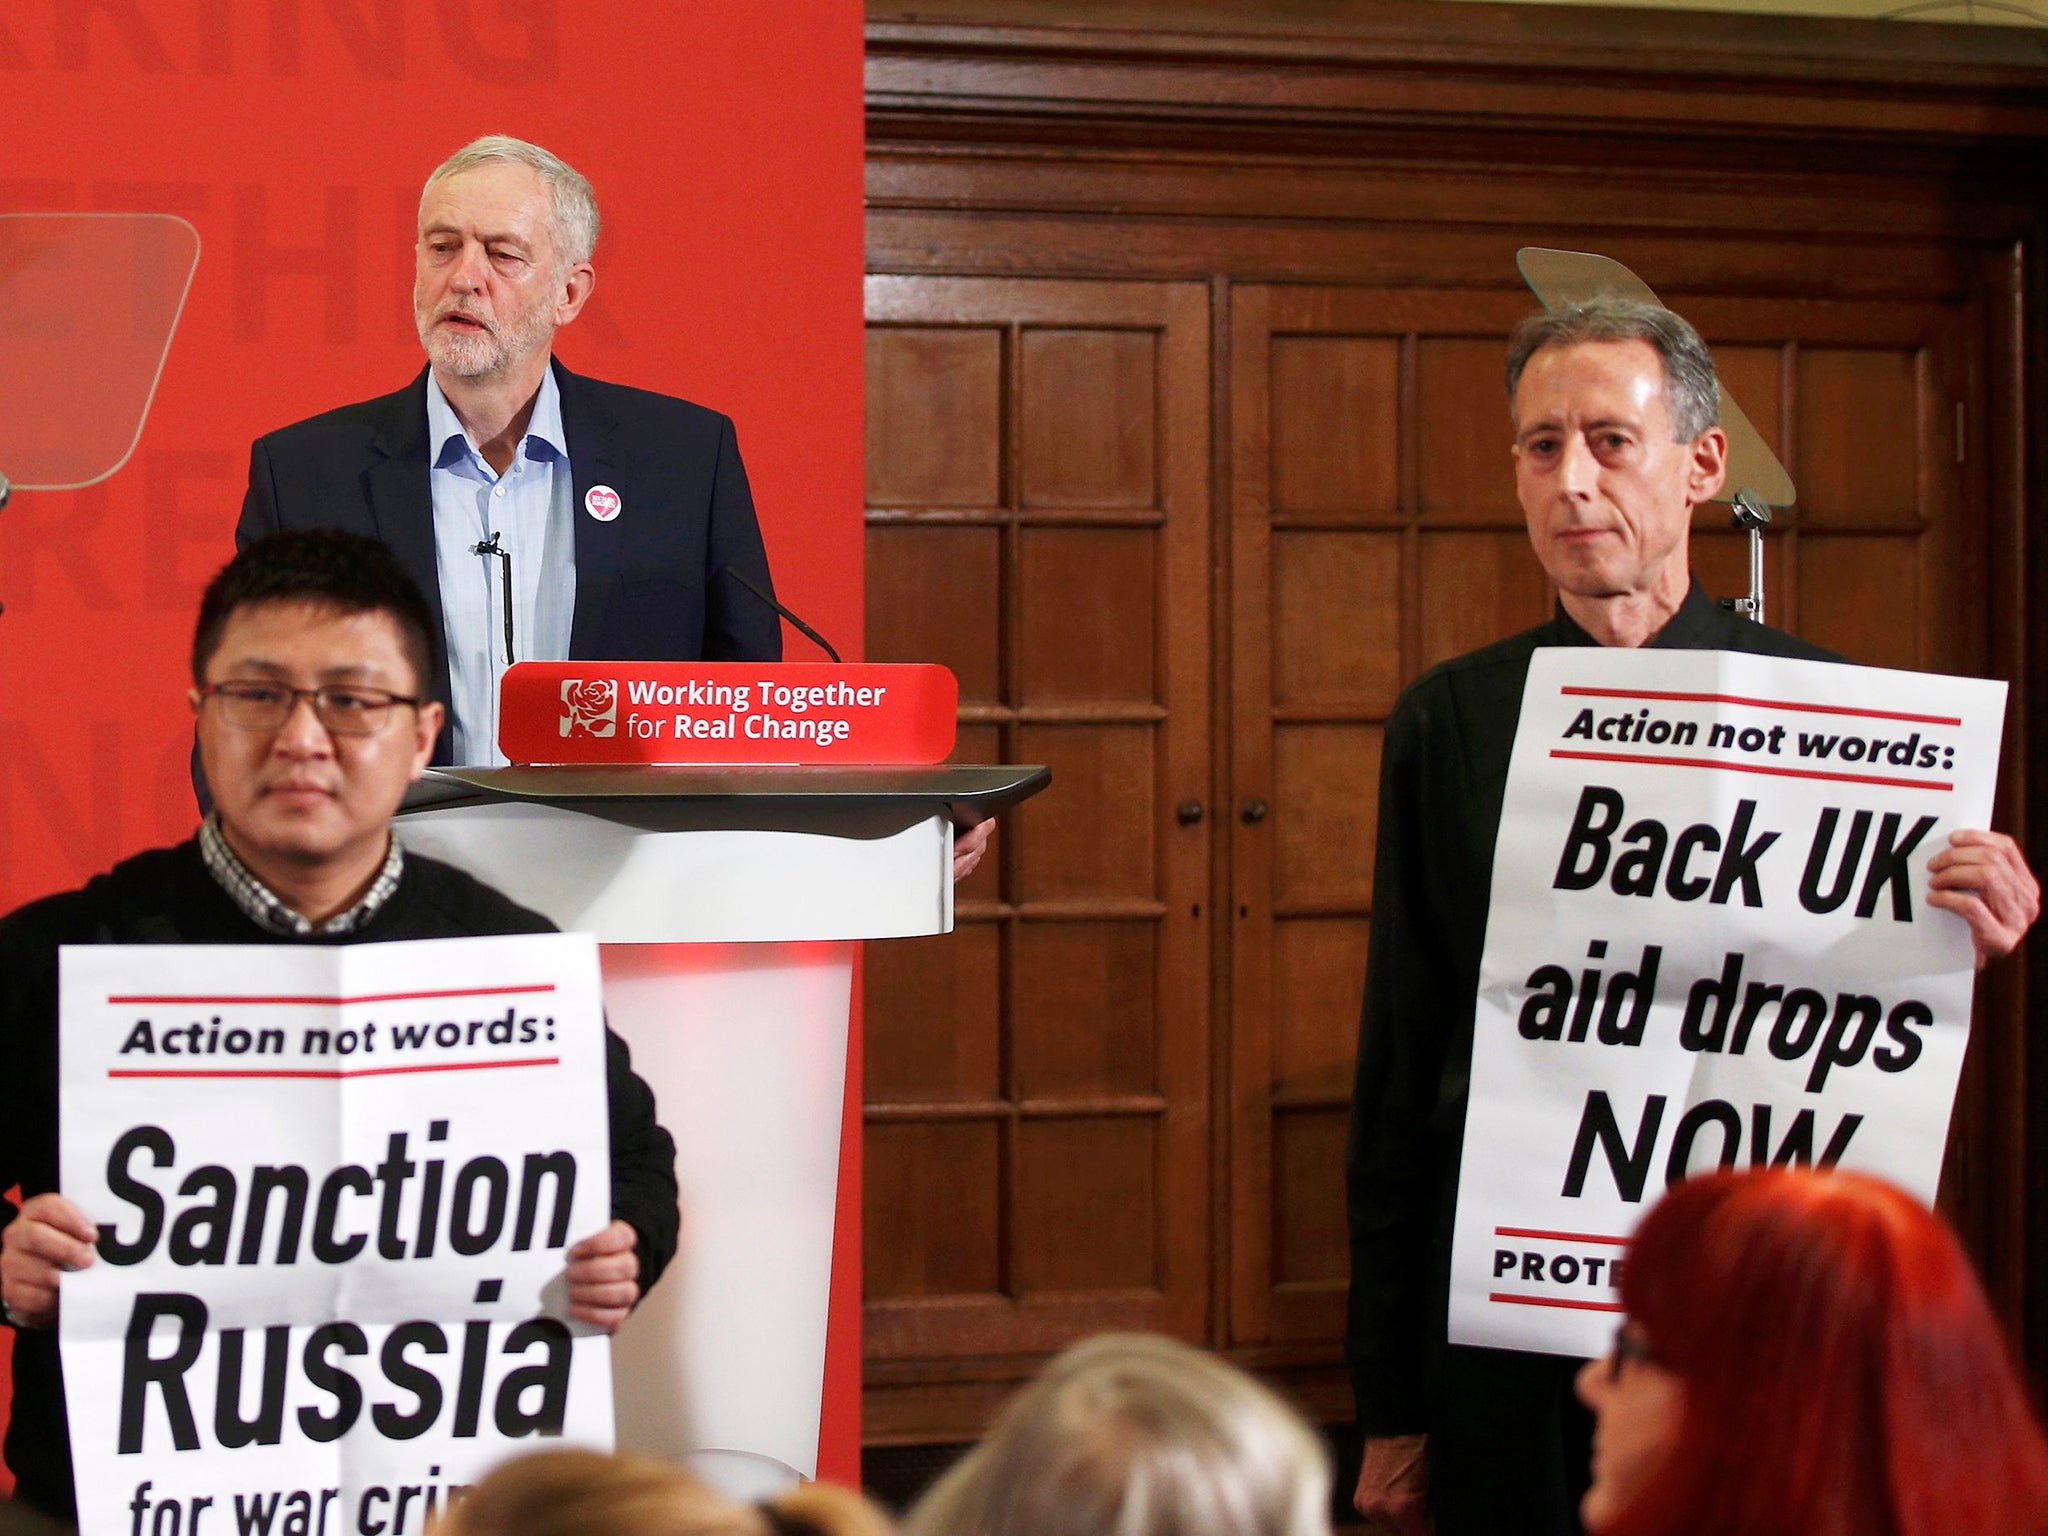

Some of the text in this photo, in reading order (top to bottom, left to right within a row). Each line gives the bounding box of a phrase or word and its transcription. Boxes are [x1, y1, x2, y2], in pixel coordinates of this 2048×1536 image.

[626, 713, 850, 746] for Real Change
[627, 680, 886, 712] Working Together
[1562, 708, 1956, 771] Action not words:
[1553, 785, 1938, 923] Back UK
[120, 1008, 556, 1055] Action not words:
[1517, 939, 1934, 1094] aid drops
[1561, 1089, 1864, 1203] NOW
[96, 1120, 578, 1267] Sanction
[117, 1279, 574, 1455] Russia
[130, 1481, 213, 1536] for
[234, 1488, 340, 1536] war
